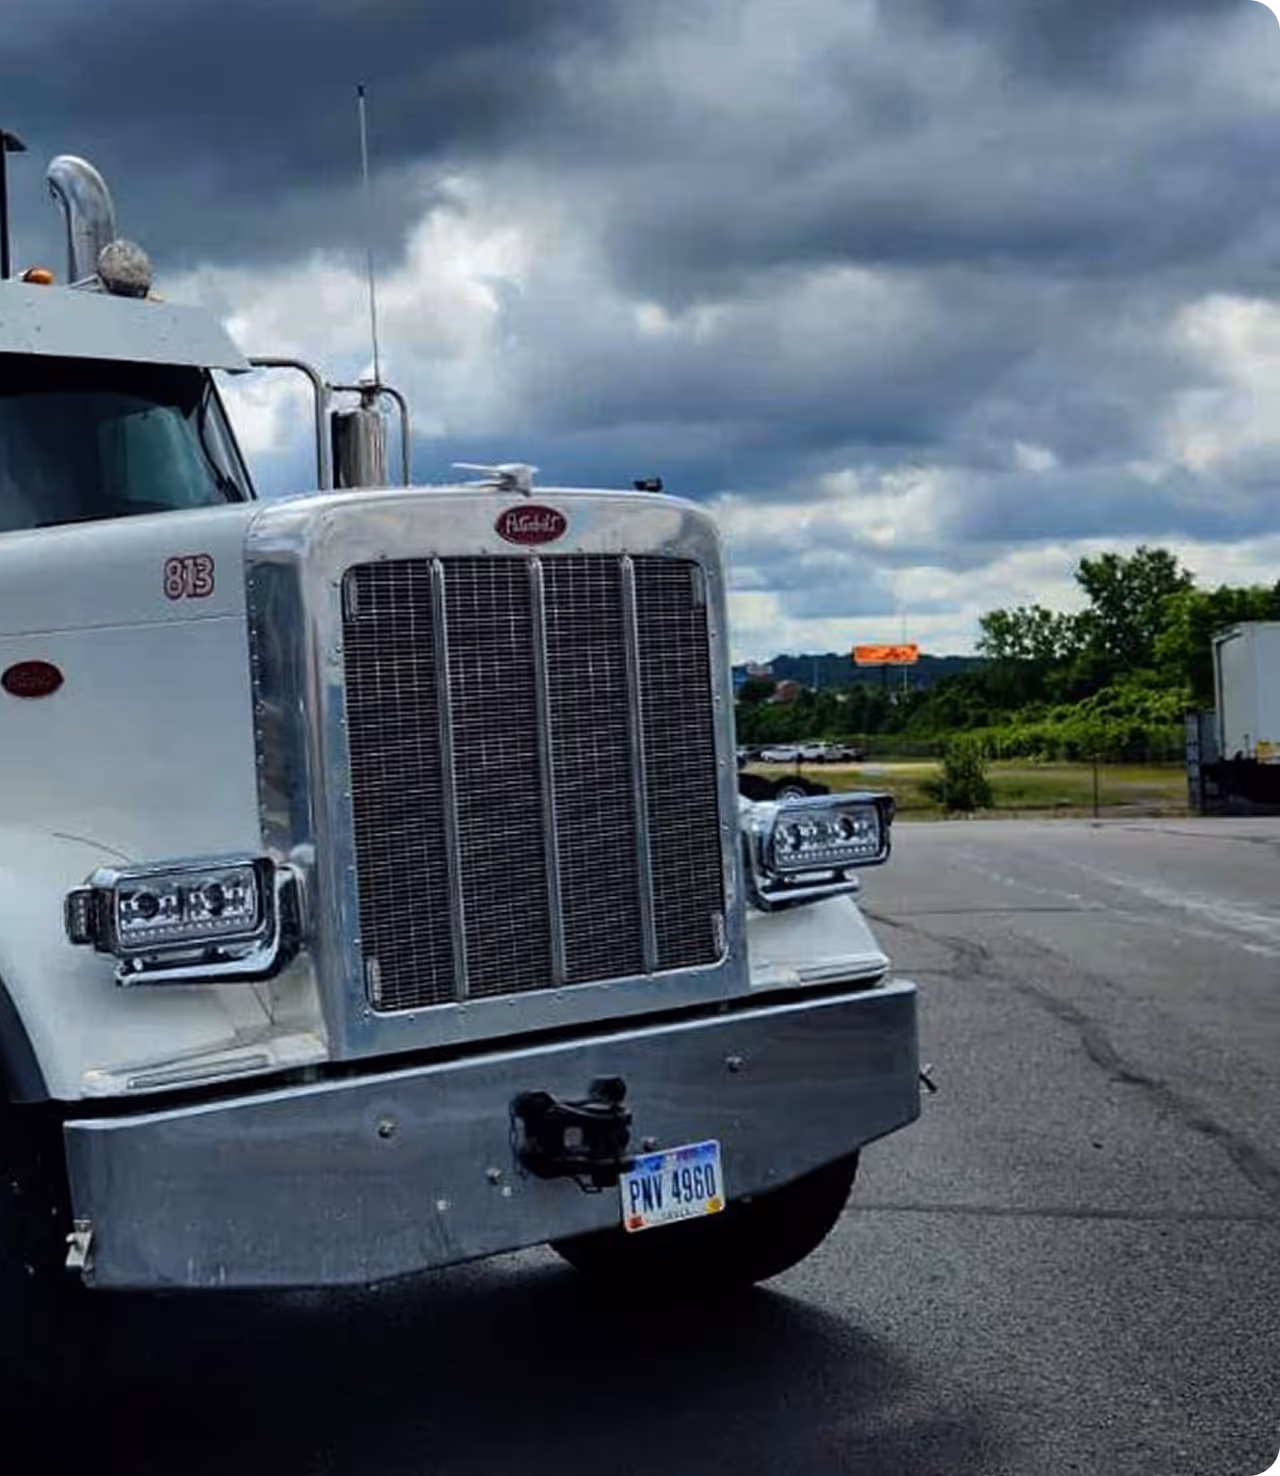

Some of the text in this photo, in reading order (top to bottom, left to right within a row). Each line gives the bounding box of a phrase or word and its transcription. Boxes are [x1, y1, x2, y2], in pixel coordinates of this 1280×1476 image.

[163, 553, 214, 601] 813
[629, 1163, 716, 1214] PNV 4960
